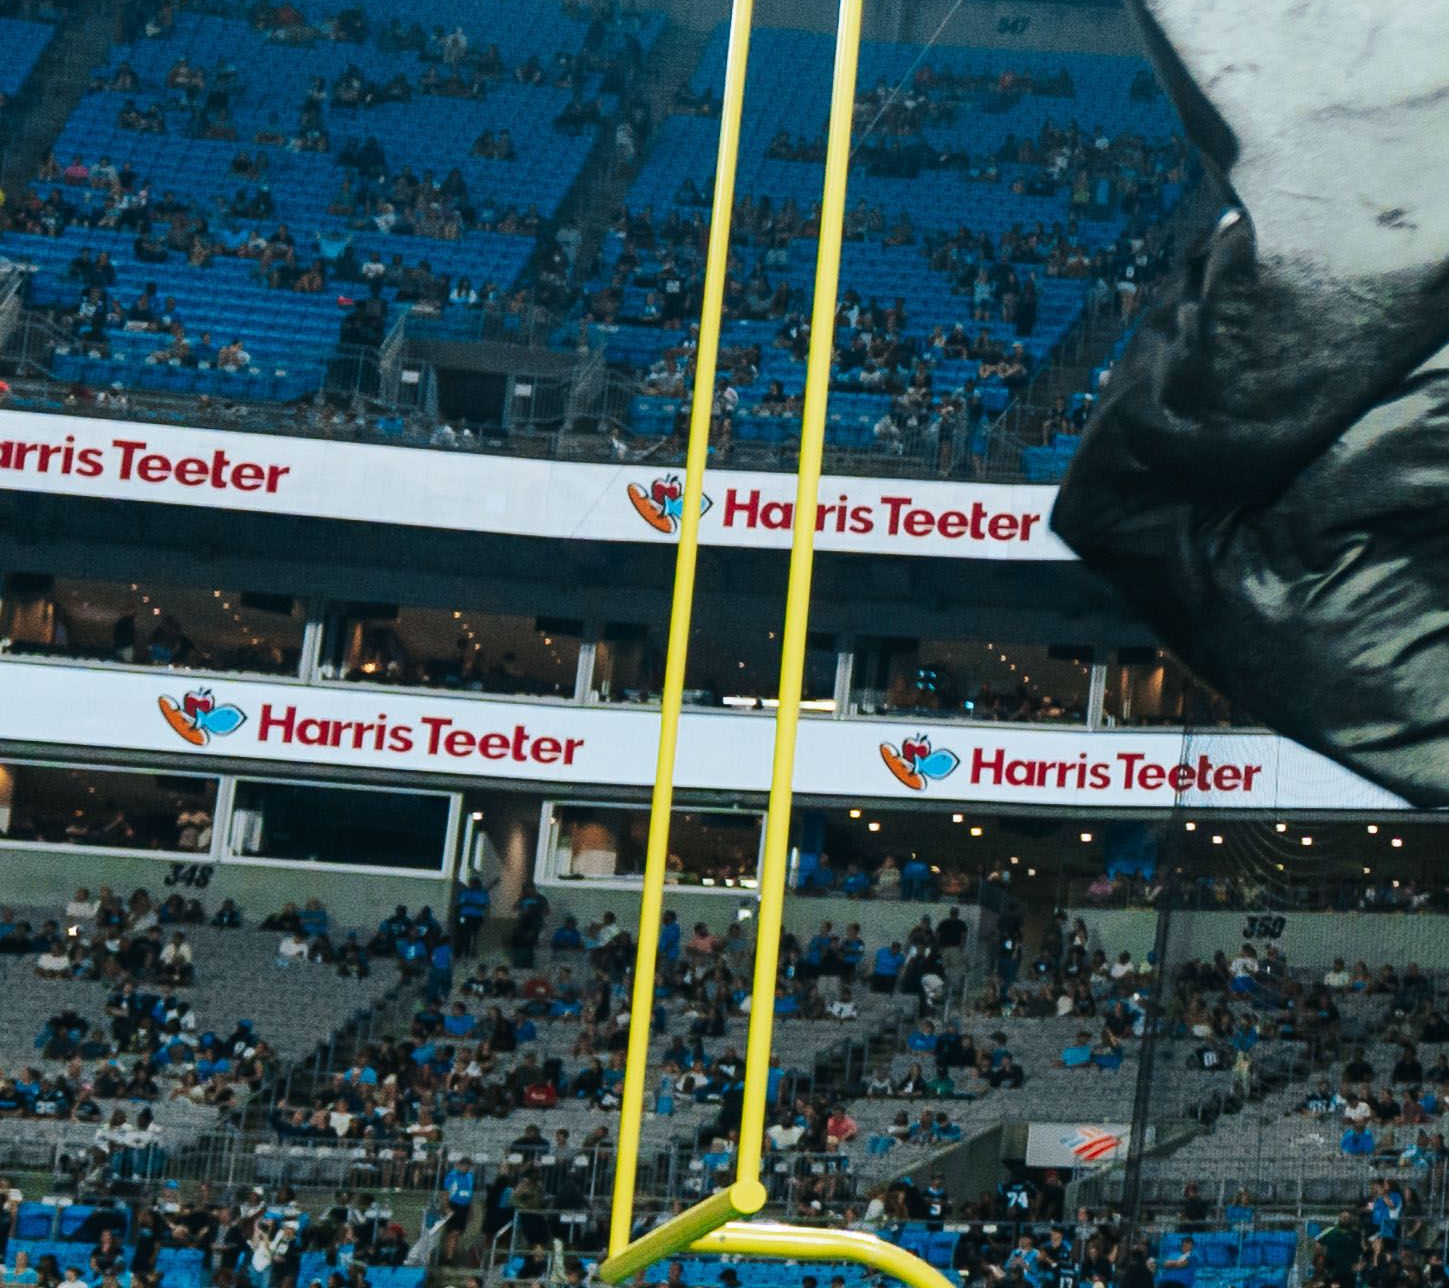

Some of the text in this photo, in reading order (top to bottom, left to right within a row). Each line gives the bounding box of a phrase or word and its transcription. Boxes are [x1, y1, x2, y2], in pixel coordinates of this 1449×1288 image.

[0, 435, 290, 493] arris Teeter
[723, 489, 1041, 542] Haris Teeter
[258, 704, 585, 766] Harris Teeter
[970, 747, 1262, 793] Harris Teeter
